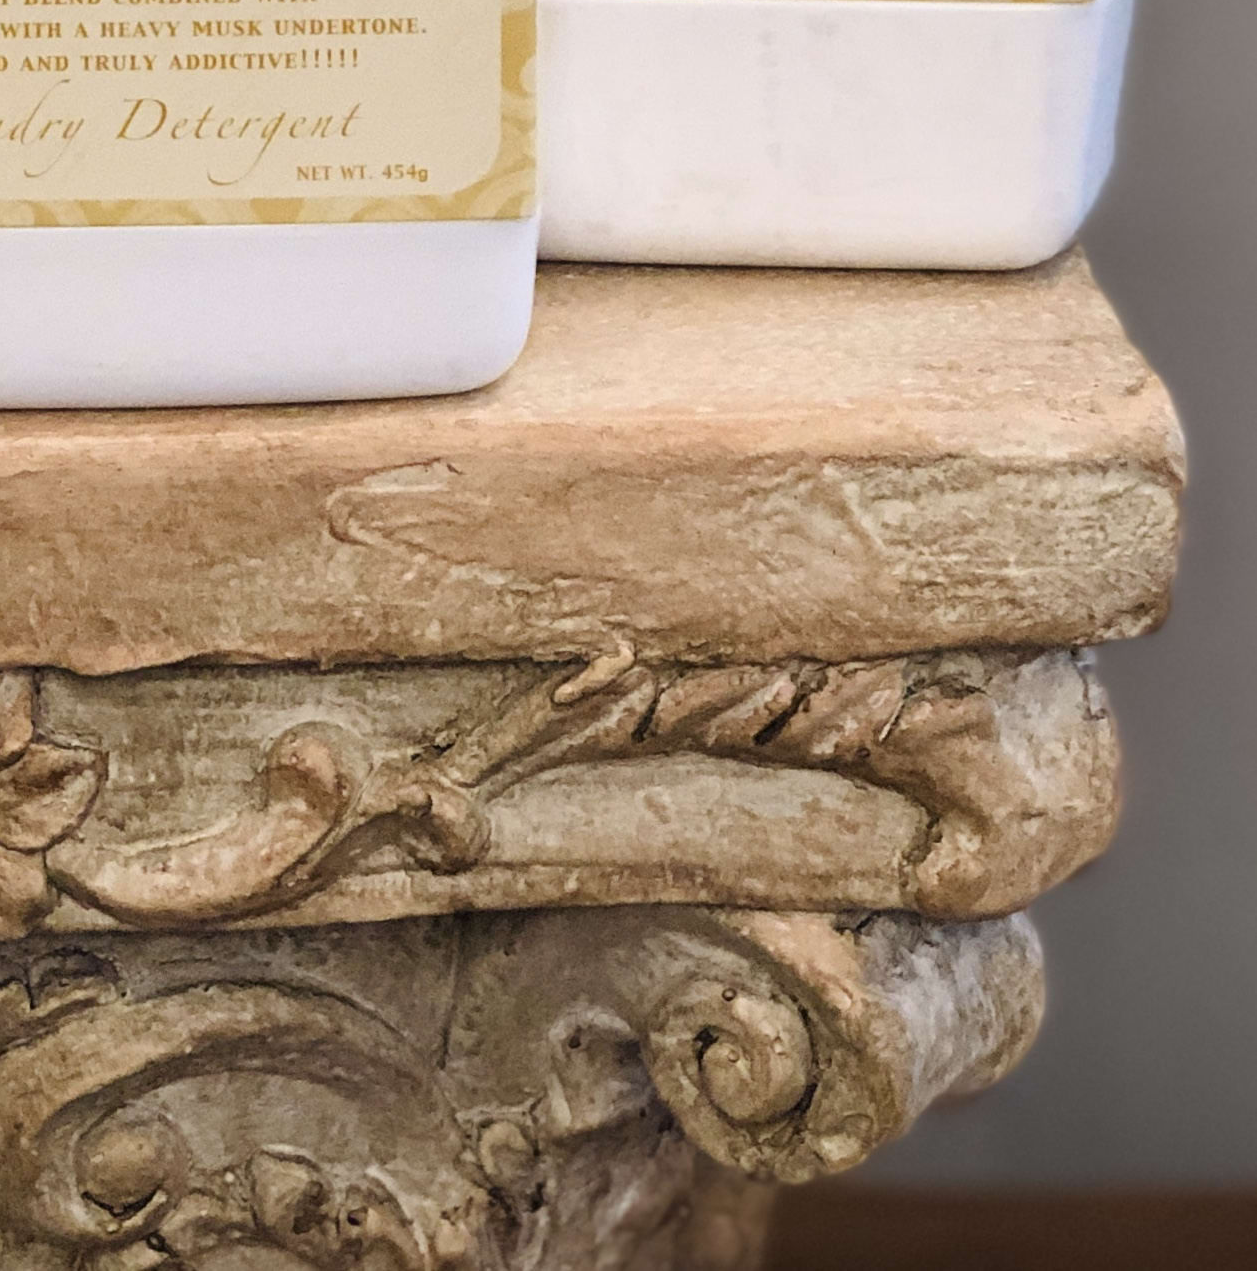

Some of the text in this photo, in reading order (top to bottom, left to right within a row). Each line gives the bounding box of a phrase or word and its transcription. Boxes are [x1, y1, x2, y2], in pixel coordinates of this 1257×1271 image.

[0, 22, 62, 39] WITH
[74, 20, 90, 39] A
[100, 20, 180, 39] HEAVY
[192, 20, 262, 37] MUSK
[274, 17, 427, 36] UNDERTONE.
[22, 55, 69, 72] AND
[81, 54, 156, 72] TRULY
[170, 48, 358, 71] ADDICTIVE!!!!!
[116, 98, 363, 187] Detergent
[296, 163, 429, 183] NET WT. 454g
